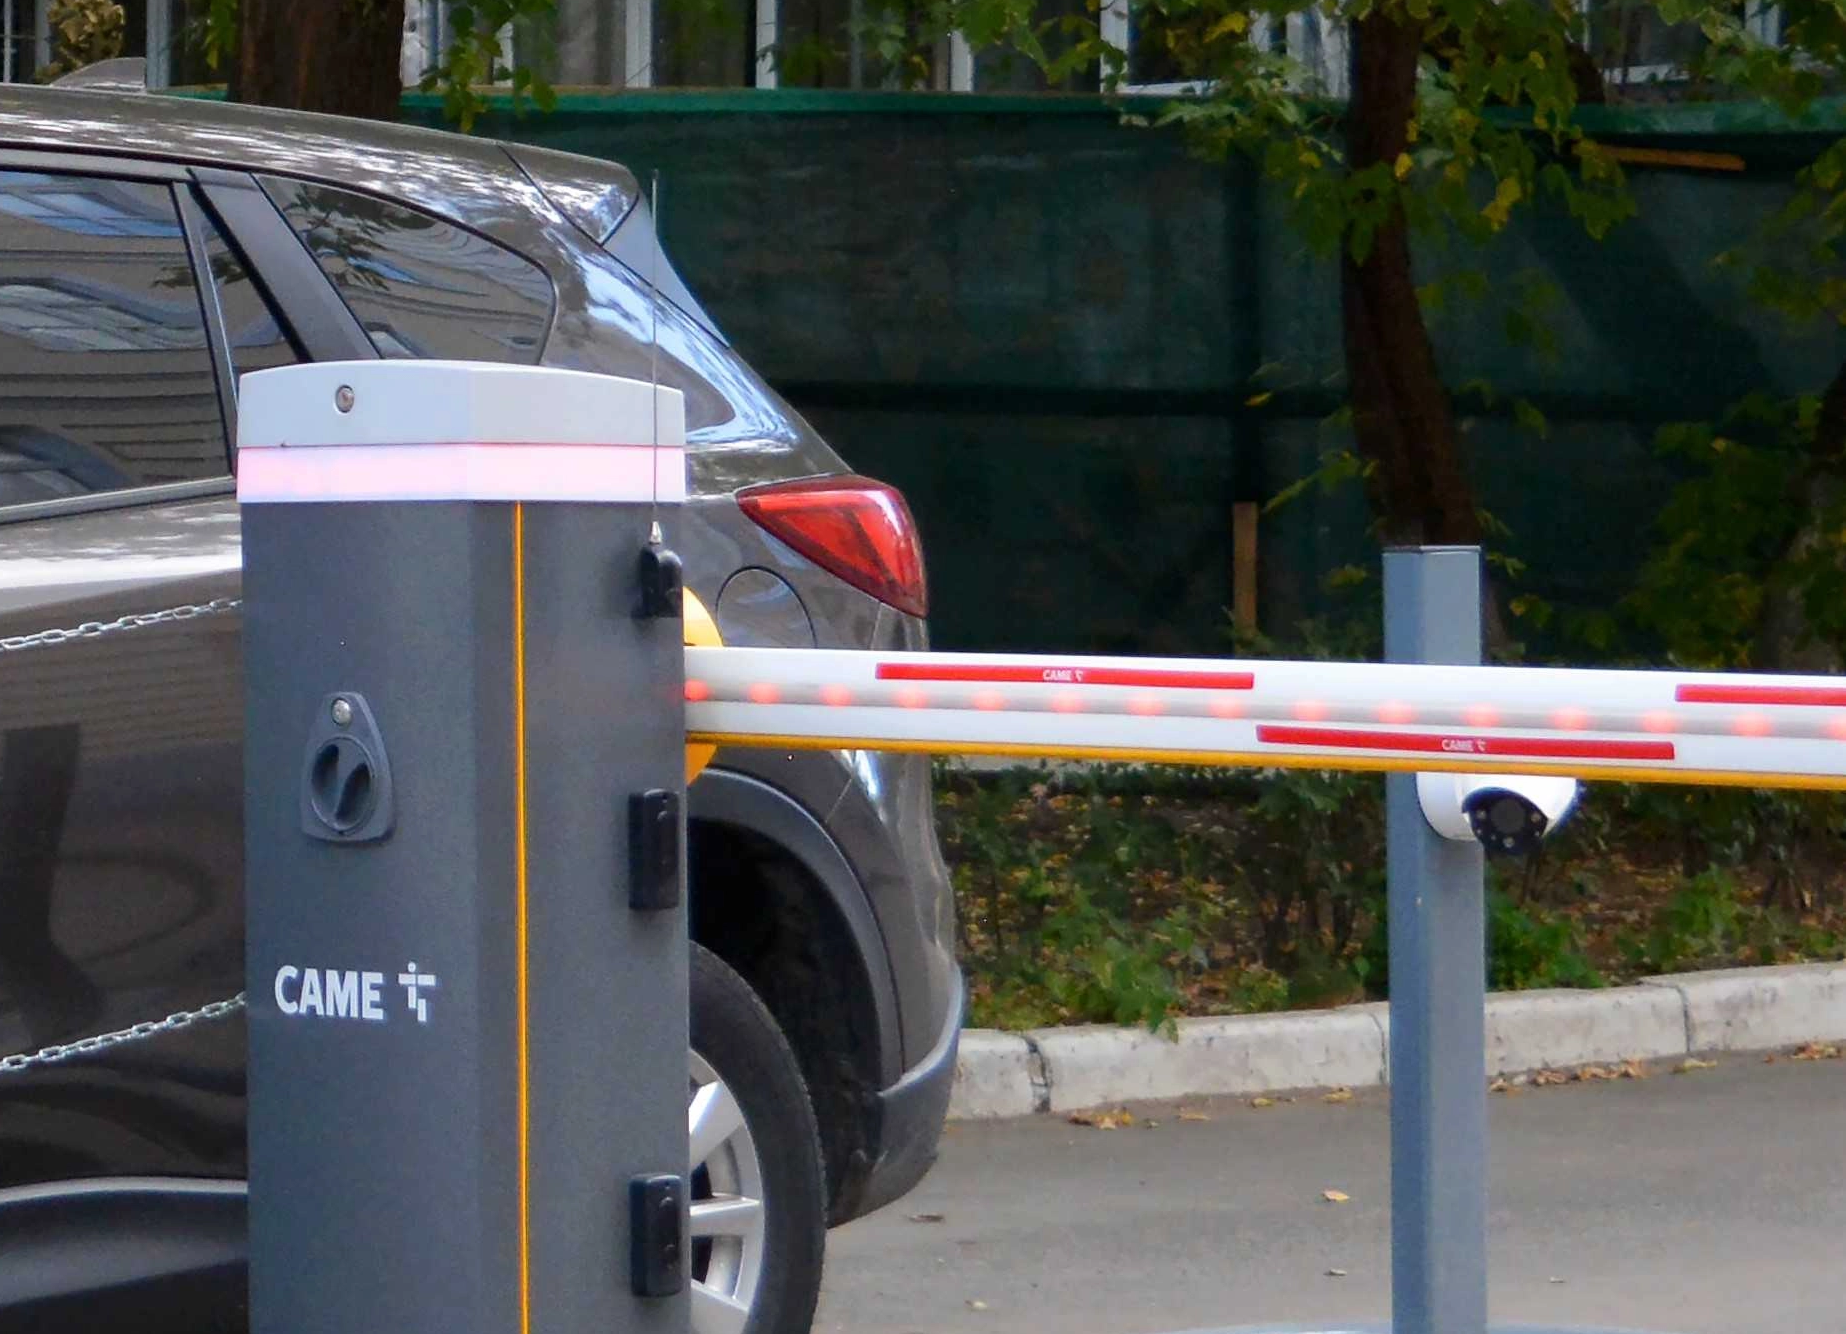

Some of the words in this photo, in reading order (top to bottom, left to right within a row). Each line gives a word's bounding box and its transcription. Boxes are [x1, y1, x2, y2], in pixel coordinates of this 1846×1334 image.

[1043, 669, 1072, 681] CAME
[1442, 739, 1474, 752] CAME
[275, 965, 384, 1019] CAME
